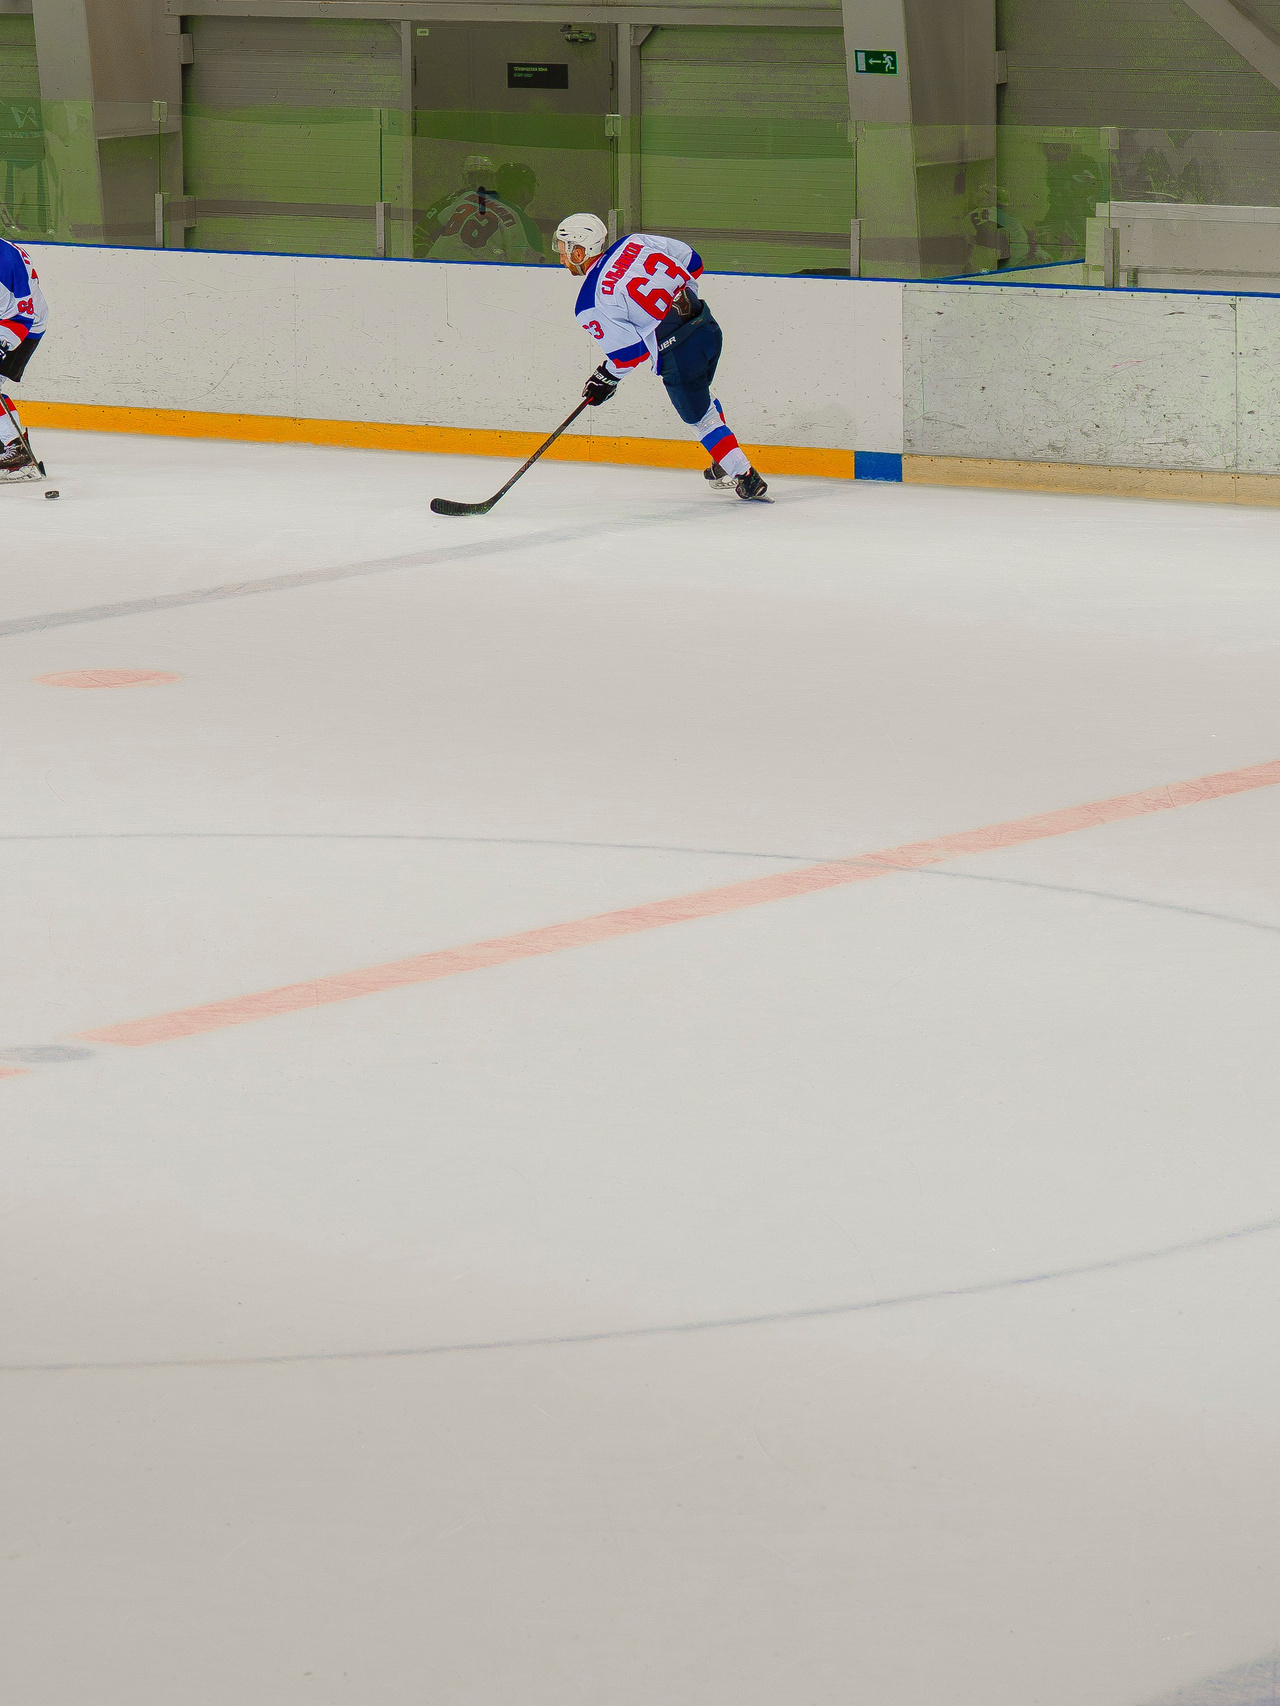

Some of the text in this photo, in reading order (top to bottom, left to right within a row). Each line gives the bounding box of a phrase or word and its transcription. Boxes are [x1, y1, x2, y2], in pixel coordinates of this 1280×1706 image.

[626, 252, 691, 321] 63
[582, 319, 605, 340] 3
[658, 336, 677, 352] UER
